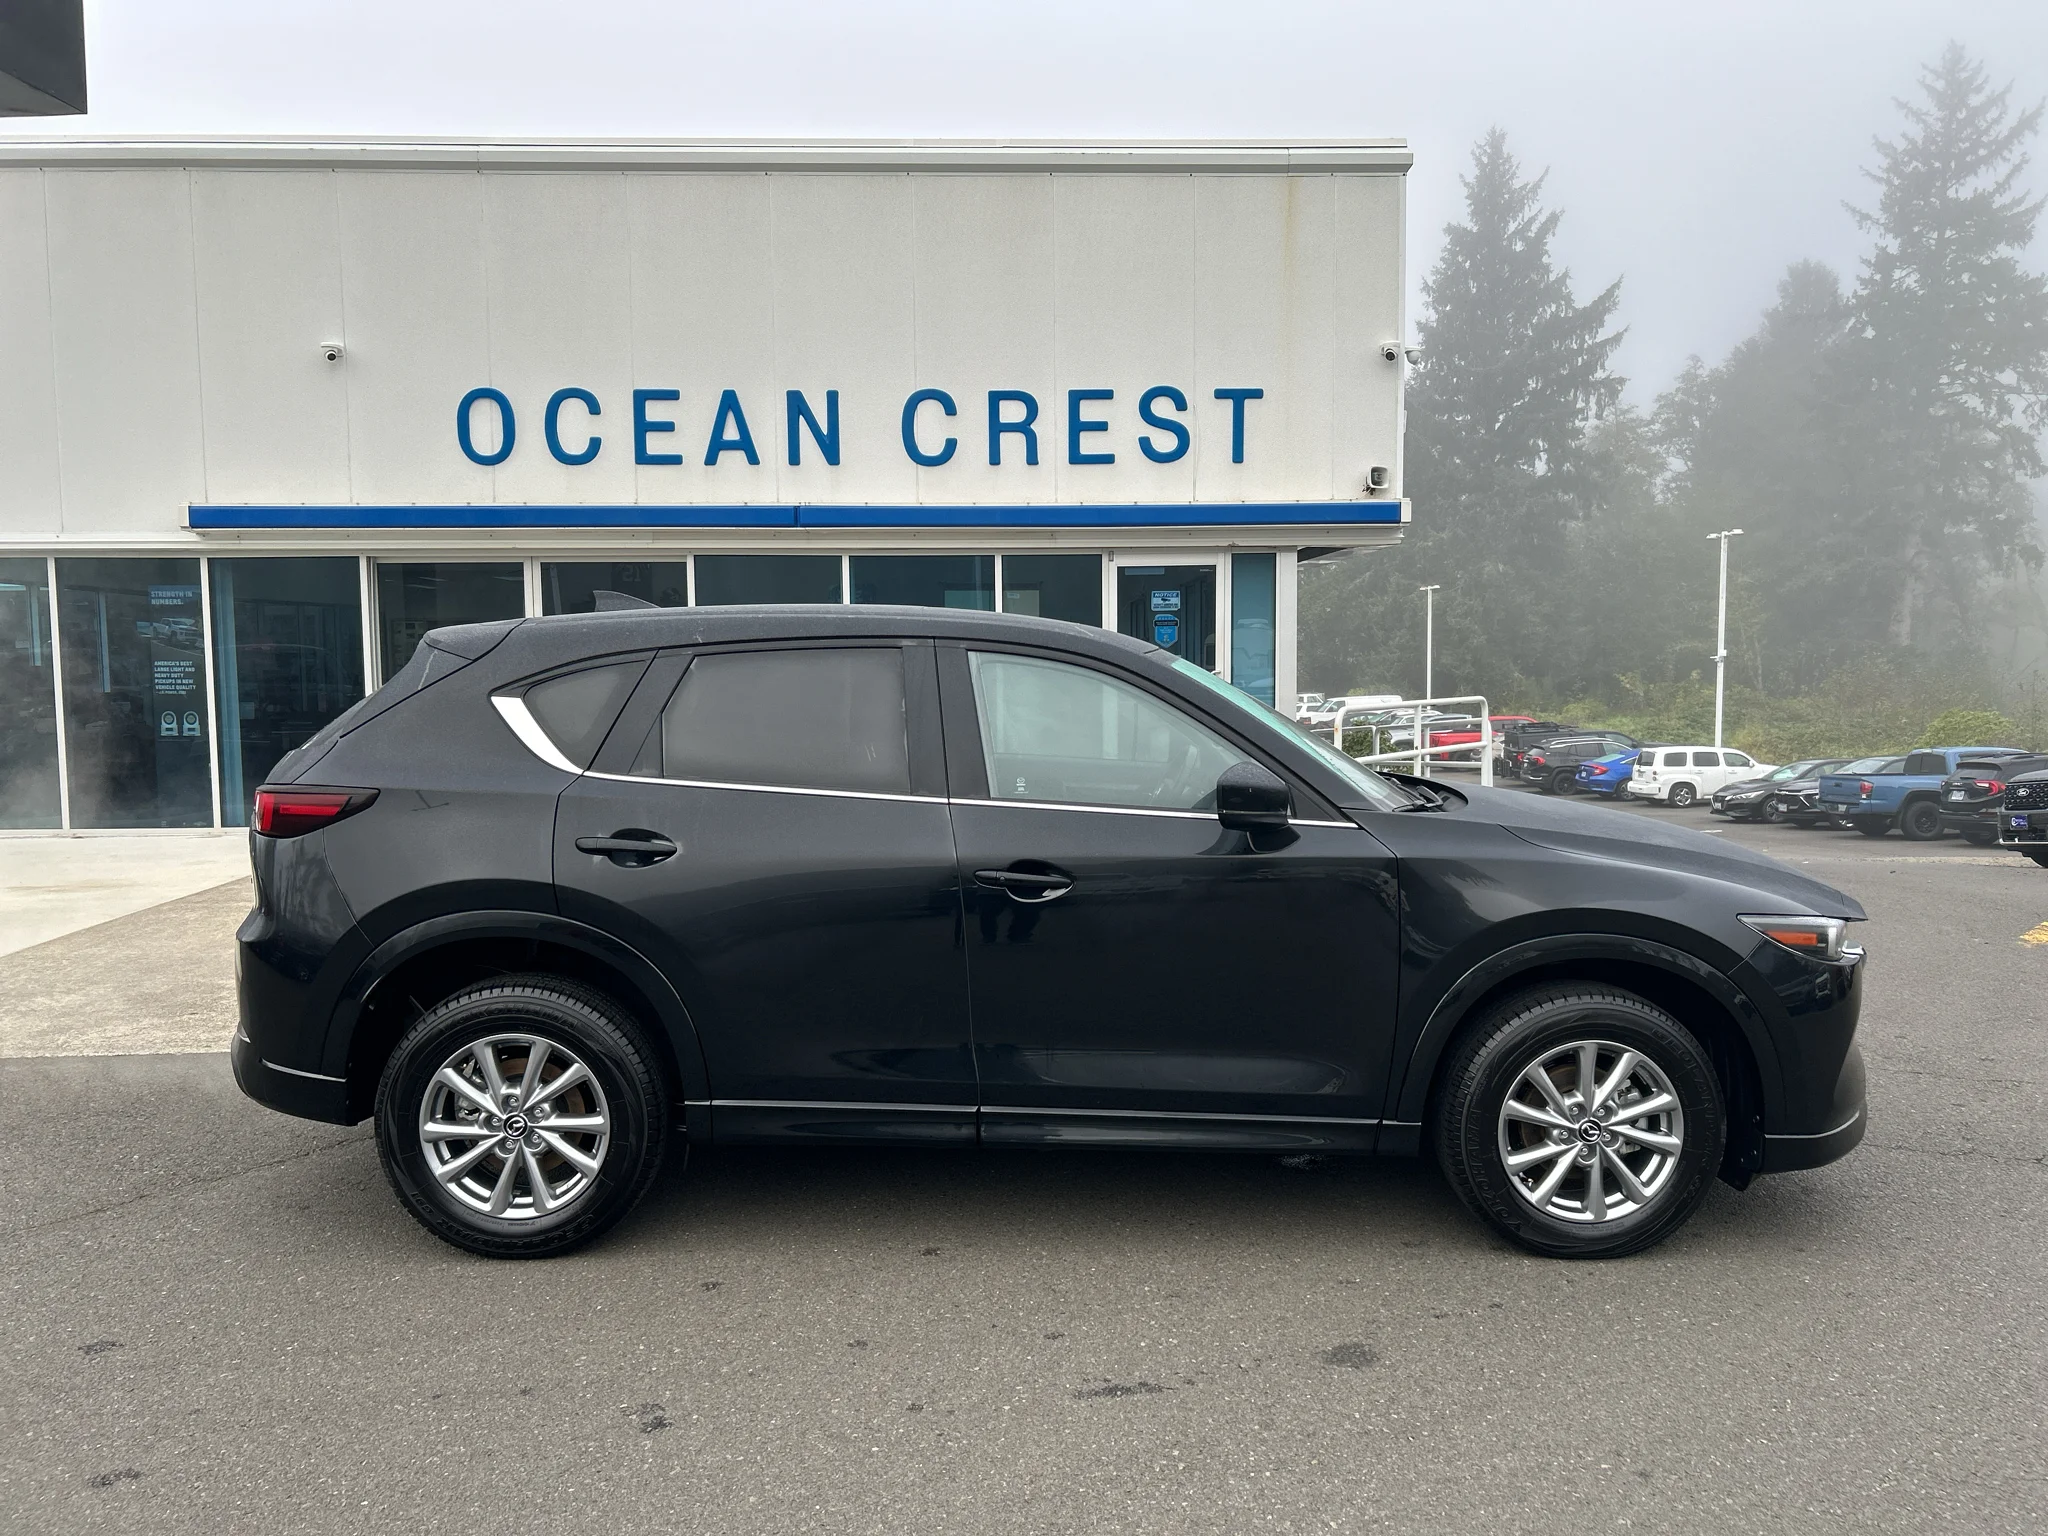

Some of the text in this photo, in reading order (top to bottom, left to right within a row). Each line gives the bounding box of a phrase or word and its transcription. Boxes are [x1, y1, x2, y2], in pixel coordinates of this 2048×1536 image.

[457, 386, 1264, 466] OCEAN CREST
[438, 1003, 578, 1032] YOKOHAMA
[1467, 1108, 1522, 1232] YOKOHAMA
